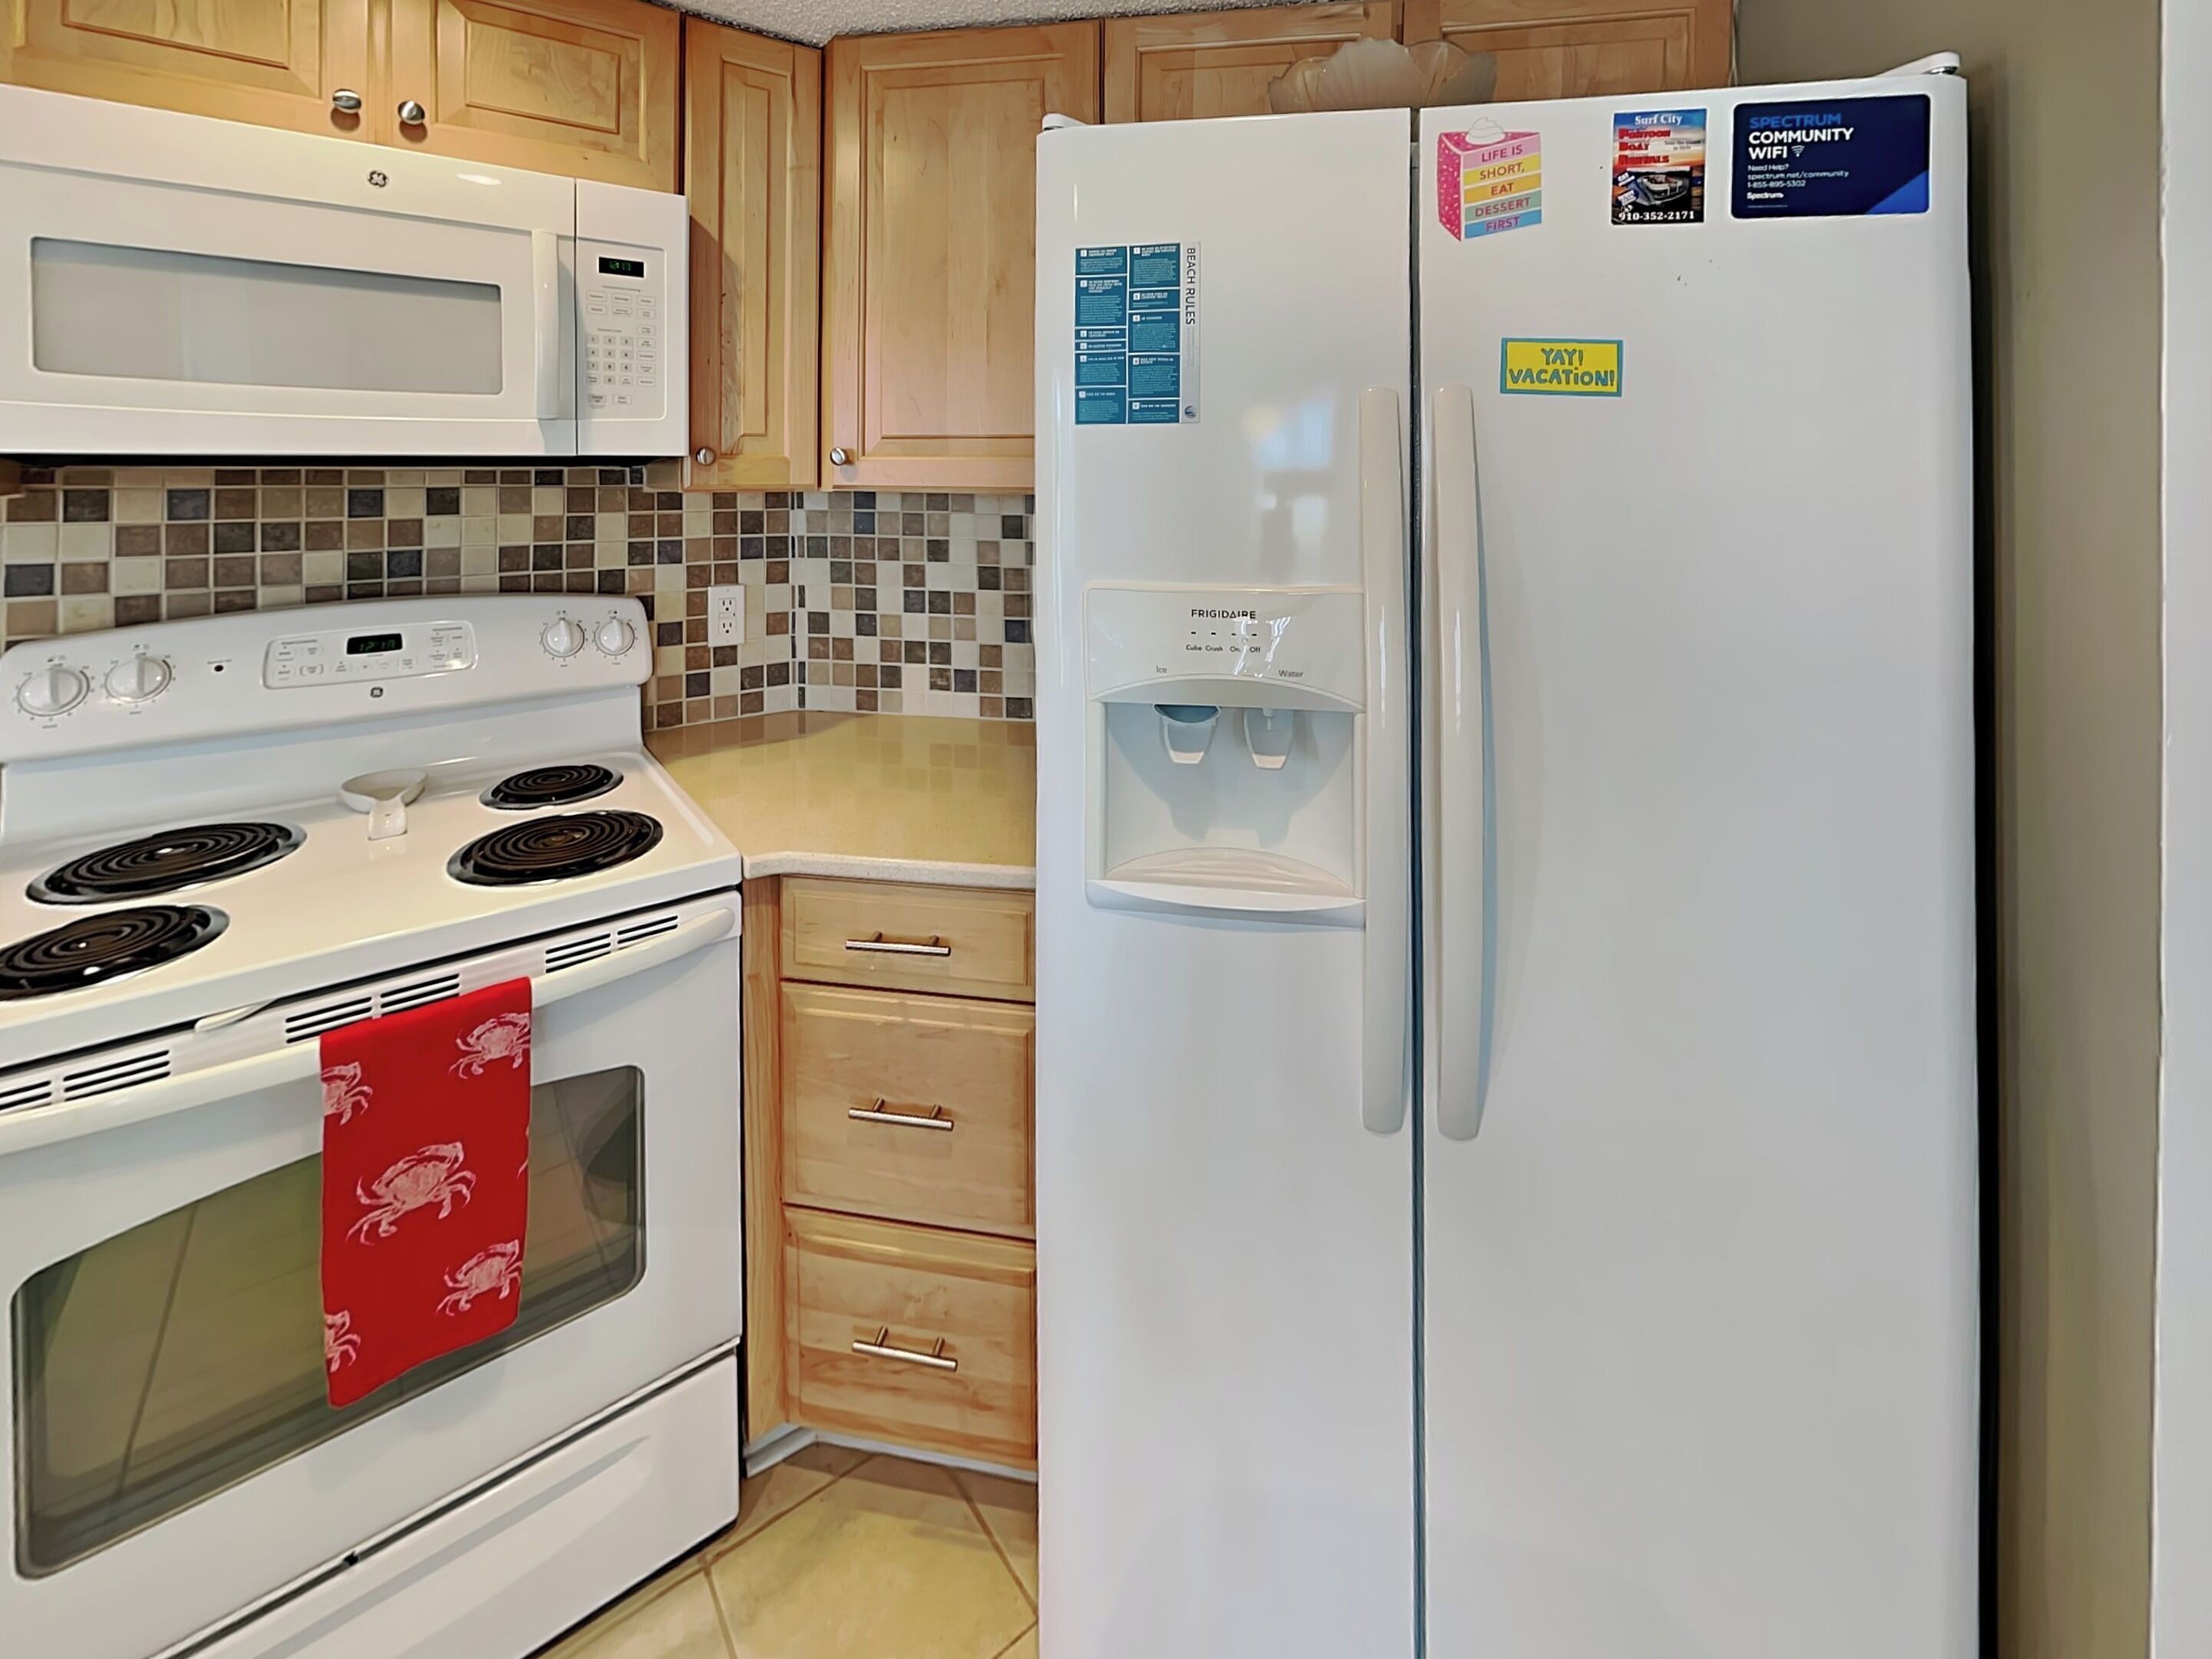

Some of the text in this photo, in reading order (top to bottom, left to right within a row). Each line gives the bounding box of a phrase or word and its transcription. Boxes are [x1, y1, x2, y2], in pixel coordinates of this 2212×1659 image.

[1634, 114, 1683, 125] Surf City
[1749, 113, 1842, 129] SPECTRUM
[1748, 127, 1854, 144] COMMUNITY
[1482, 144, 1523, 163] LIFE IS
[1748, 145, 1788, 160] WIFI
[1479, 162, 1525, 180] SHORT,
[1747, 171, 1849, 180] spectrum.net/community
[1491, 183, 1515, 197] EAT
[1747, 191, 1782, 200] Spectrum
[1475, 197, 1532, 217] DESSERT
[1618, 210, 1695, 221] 910-352-2171
[1486, 217, 1521, 232] FIRST
[1186, 247, 1196, 284] BEACH
[1185, 287, 1195, 325] RULES
[1541, 348, 1584, 366] YAY!
[1190, 609, 1257, 619] FRIGIDAIRE
[1156, 665, 1167, 674] Ice
